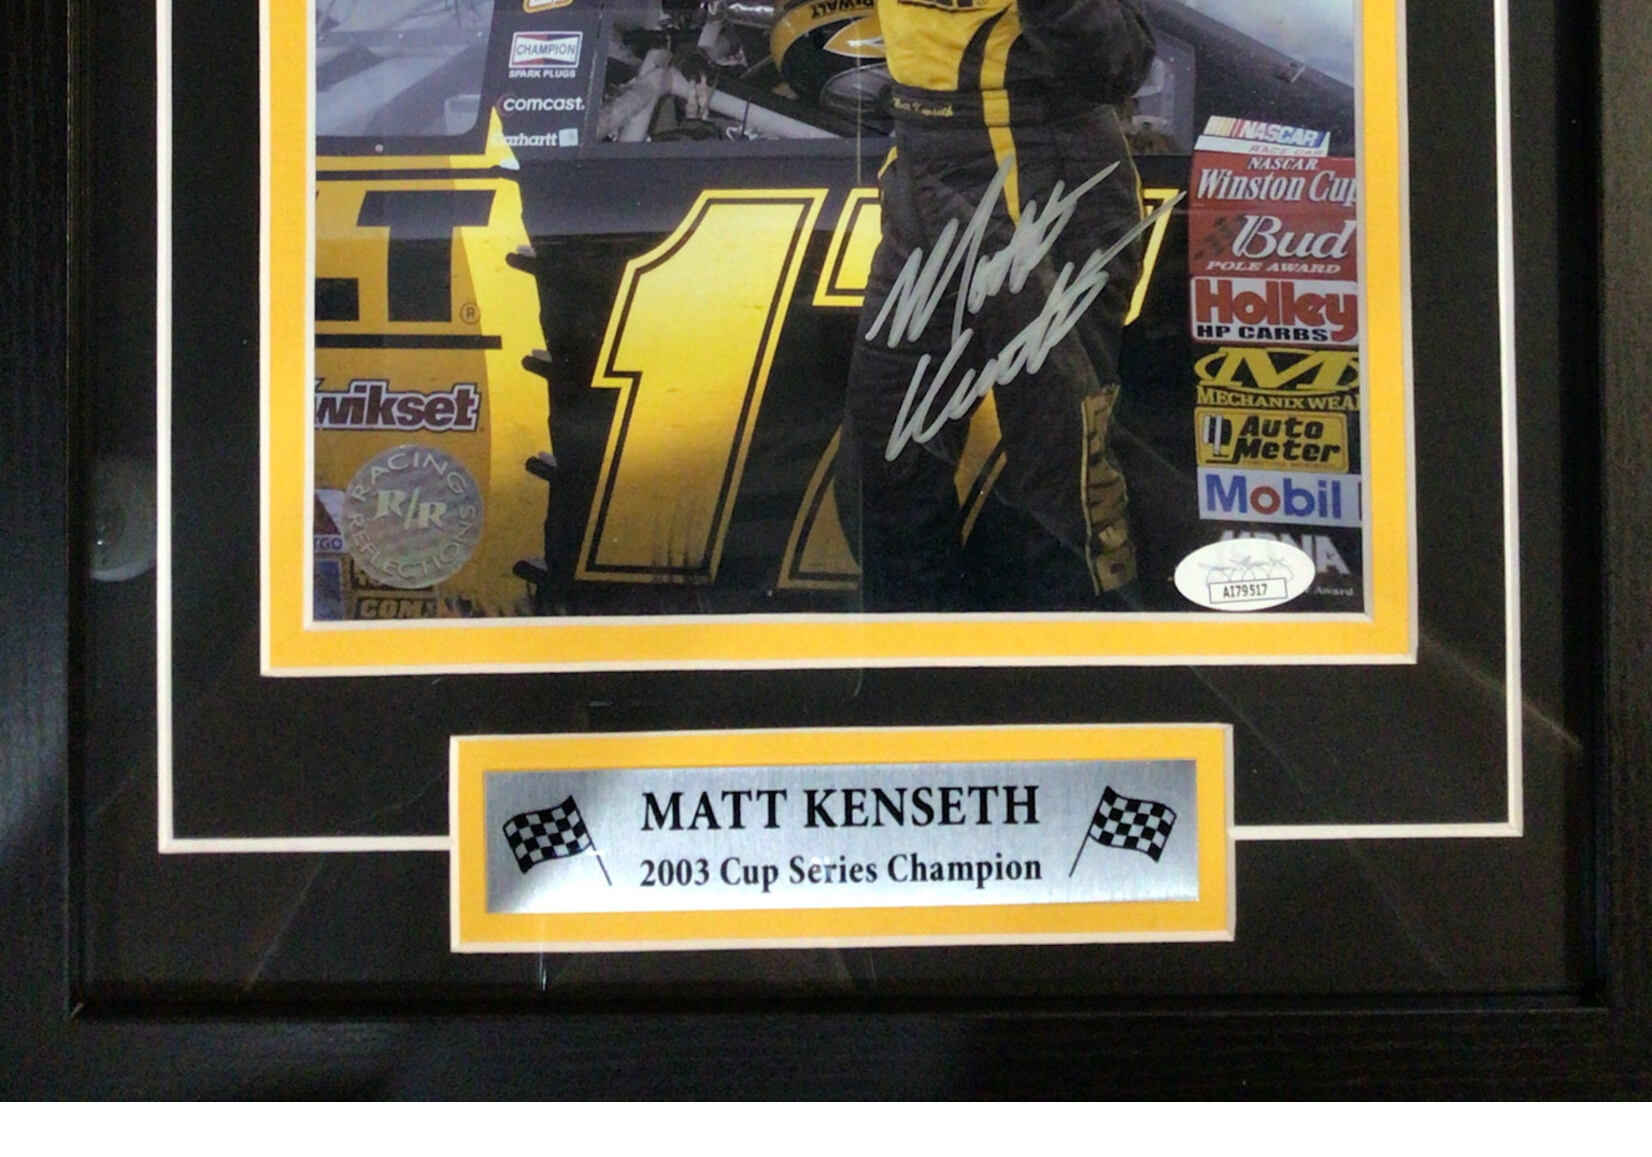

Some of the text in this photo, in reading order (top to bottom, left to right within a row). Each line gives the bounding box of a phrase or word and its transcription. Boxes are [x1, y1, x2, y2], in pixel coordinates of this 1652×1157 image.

[516, 43, 575, 56] CHAMPION
[508, 69, 576, 78] SPARK PLUGS
[506, 133, 557, 146] arhartt
[1240, 120, 1320, 147] NASCAR
[1250, 145, 1323, 157] RACE CAR
[1247, 157, 1318, 171] NASCAR
[1197, 169, 1306, 201] Winston
[1232, 215, 1357, 259] Bud
[1206, 260, 1341, 274] POLE AWARD
[1195, 279, 1359, 342] Holley
[1197, 325, 1329, 342] HP CARBS
[315, 381, 480, 430] wikset
[1196, 385, 1305, 409] MECHANIX
[1239, 416, 1324, 439] Auto
[1234, 438, 1341, 463] Meter
[352, 451, 468, 502] RACING
[1205, 474, 1342, 519] Mobil
[348, 502, 476, 580] REFLECTIONS
[1223, 583, 1268, 599] AI79517
[360, 598, 437, 620] COM
[641, 784, 1040, 832] MATT KENSETH
[640, 853, 1043, 894] 2003 Cup Series Champion
